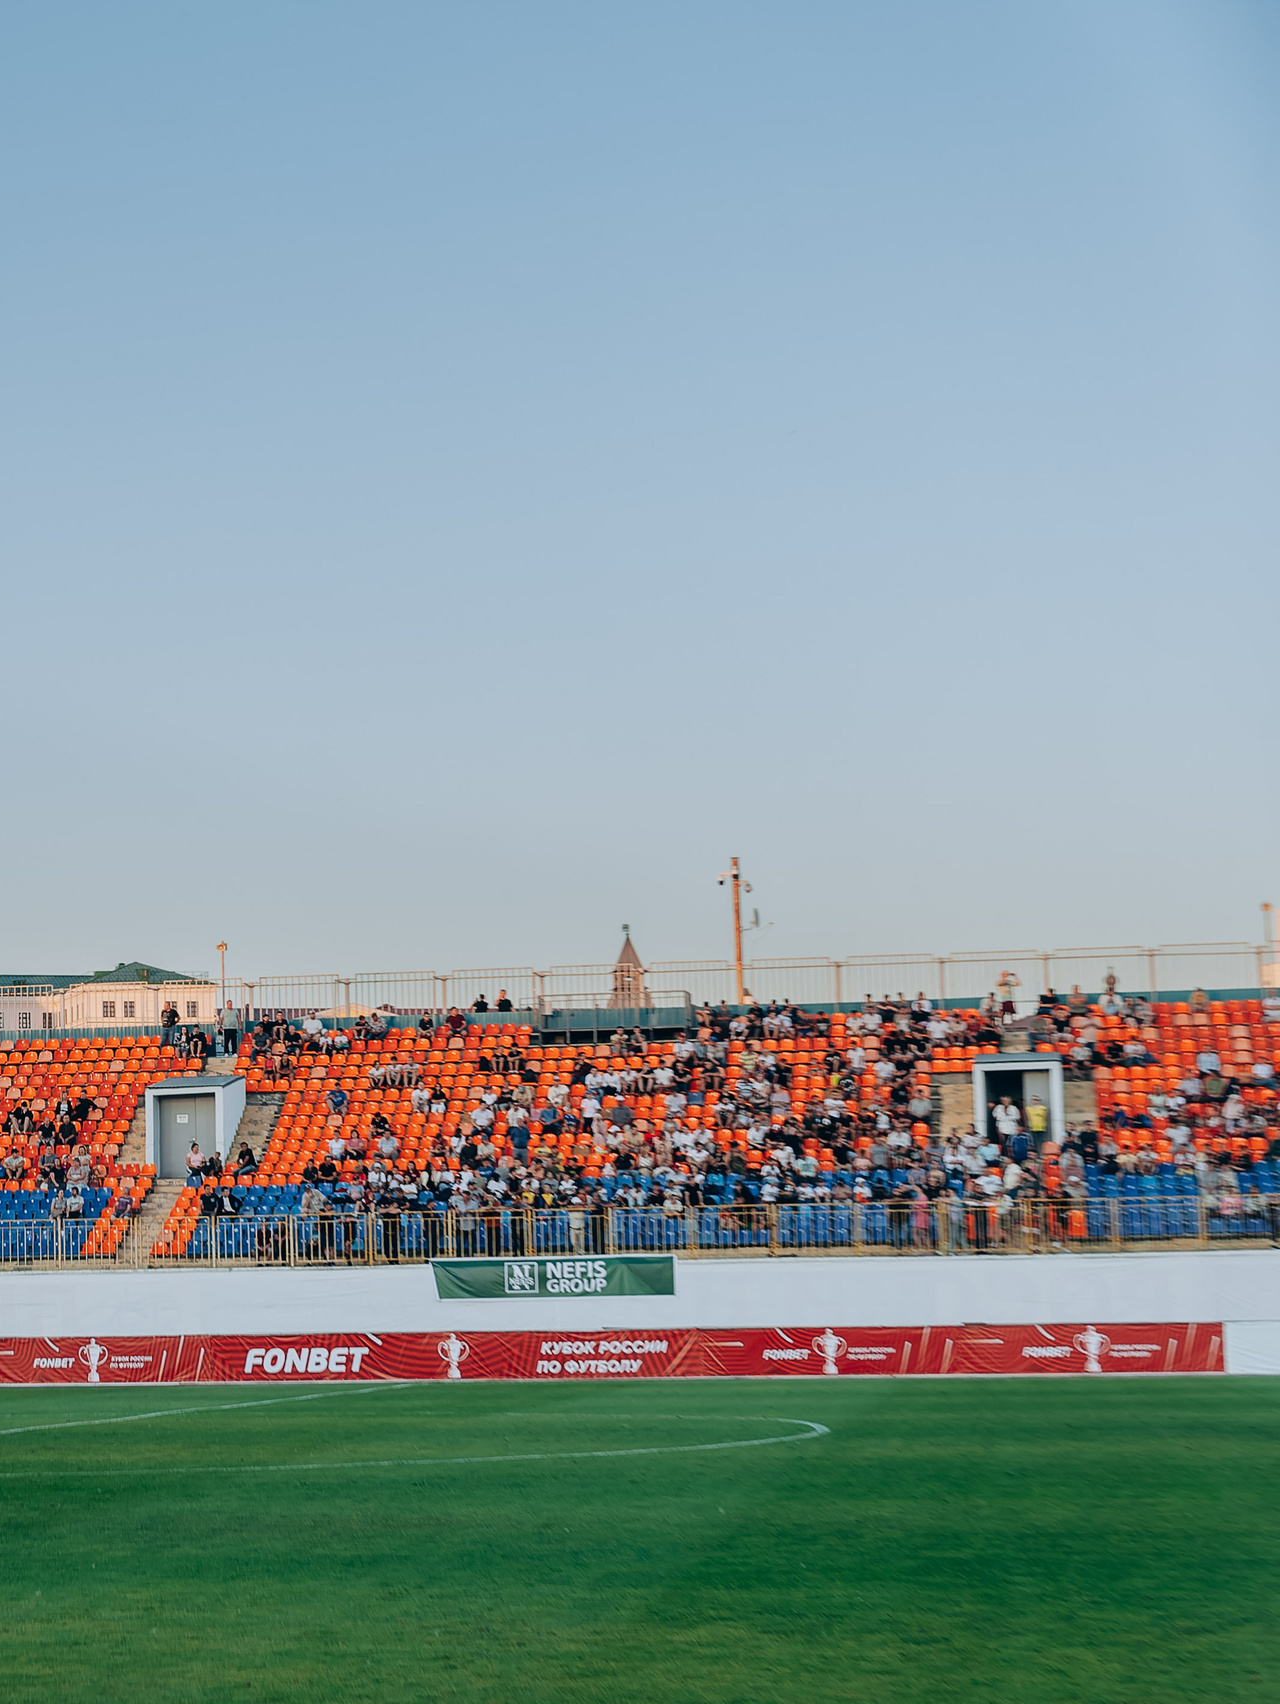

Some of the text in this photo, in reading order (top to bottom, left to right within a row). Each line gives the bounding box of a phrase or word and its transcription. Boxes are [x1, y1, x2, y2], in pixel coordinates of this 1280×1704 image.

[546, 1261, 607, 1279] NEFIS
[546, 1278, 608, 1293] GROUP
[540, 1339, 669, 1355] КУБОК РОССИИ
[33, 1357, 75, 1369] FONBET
[244, 1346, 370, 1374] FONBET
[536, 1359, 643, 1374] ПО ФУТБОЛУ
